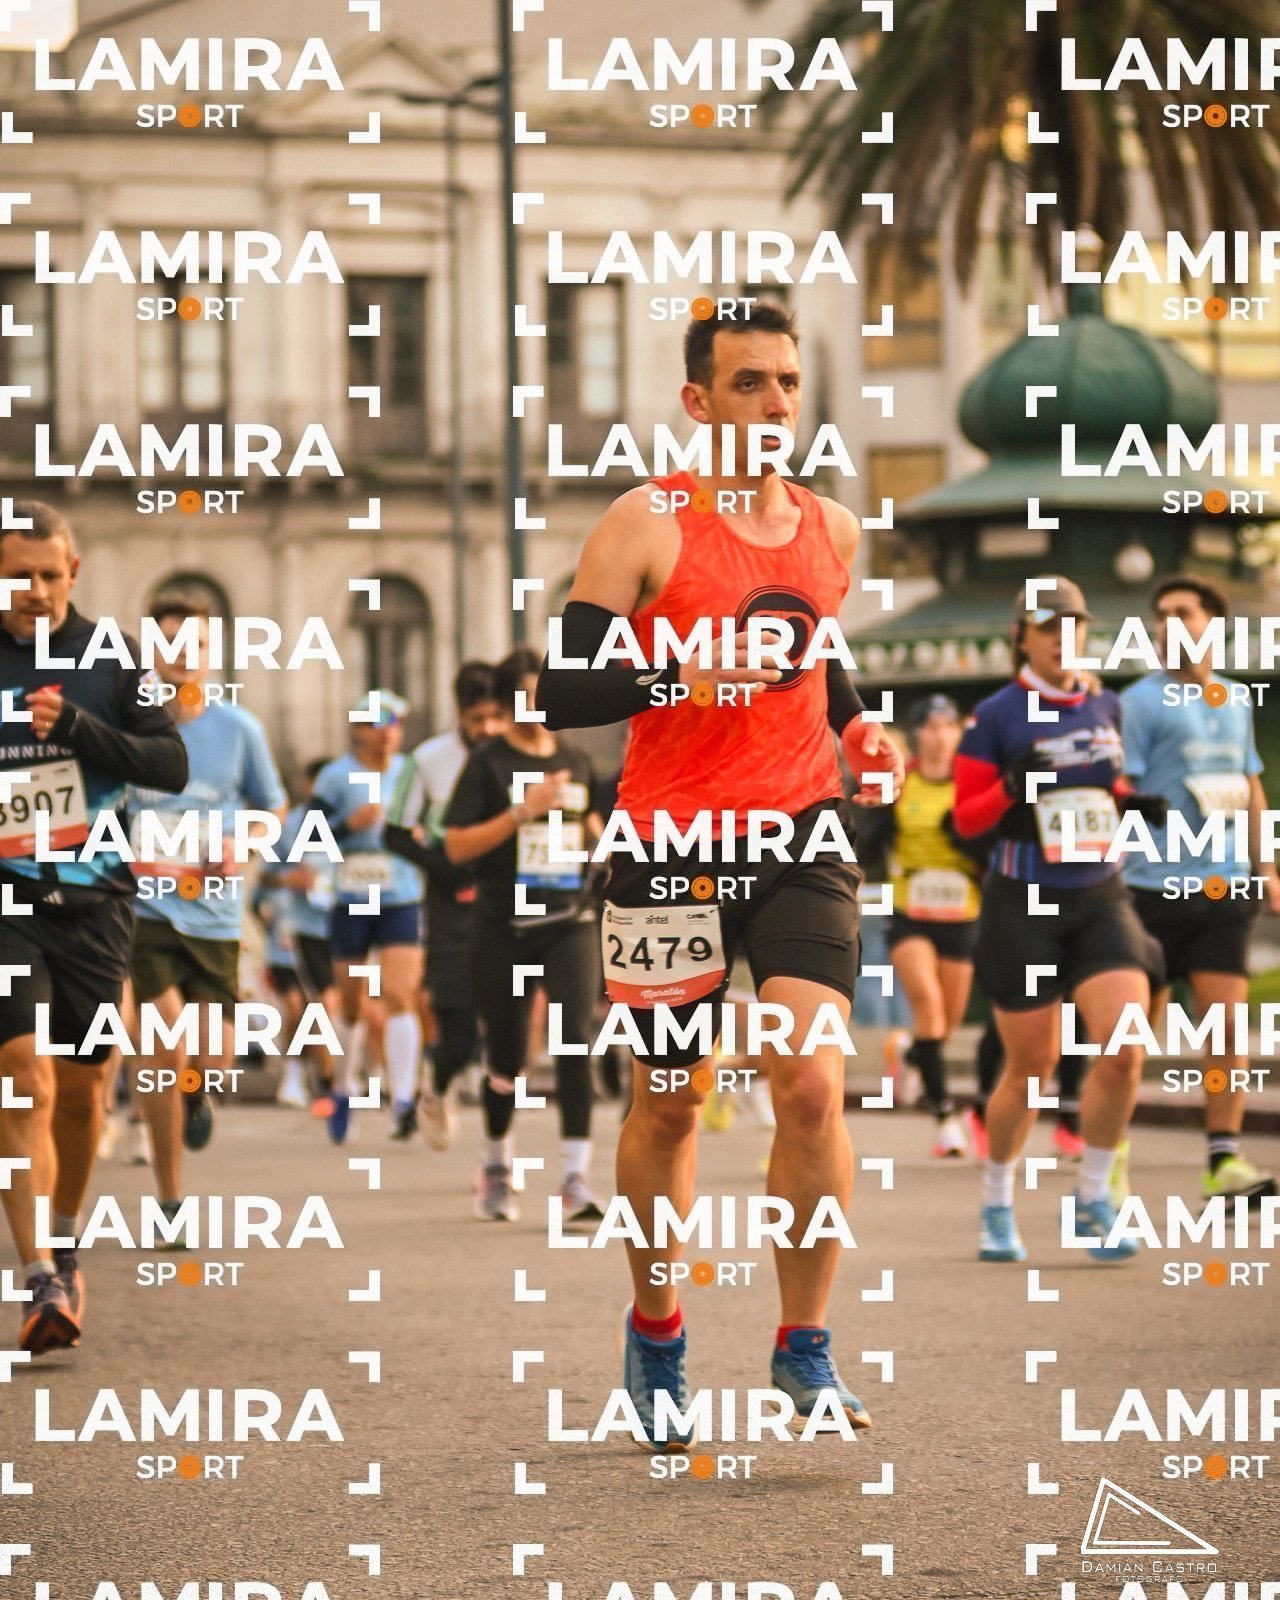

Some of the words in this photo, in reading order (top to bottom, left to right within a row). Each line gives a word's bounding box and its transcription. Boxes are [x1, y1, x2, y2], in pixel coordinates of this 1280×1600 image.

[0, 785, 74, 827] 907
[1048, 809, 1112, 833] 487
[607, 933, 713, 971] 2479
